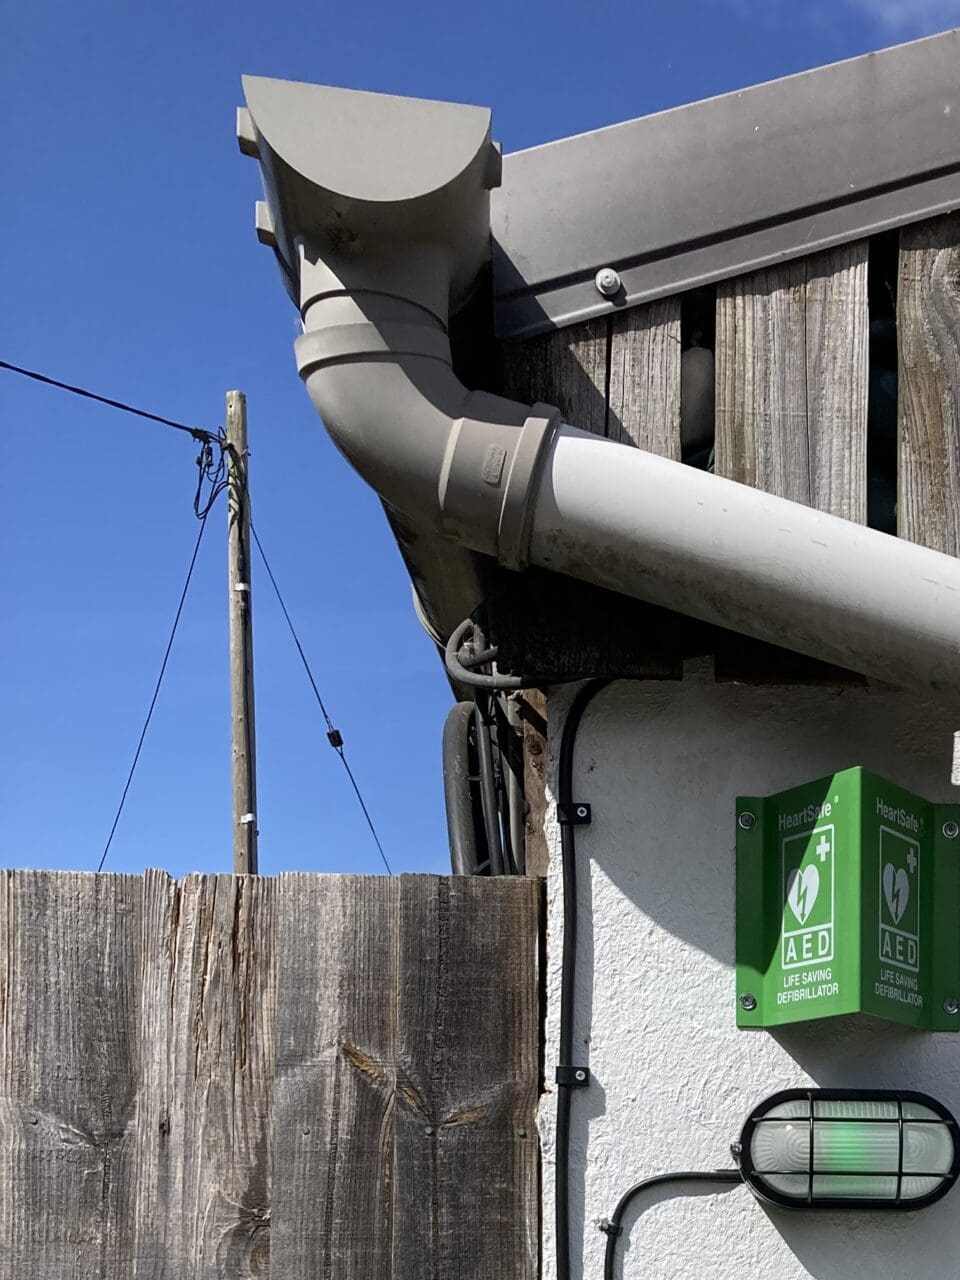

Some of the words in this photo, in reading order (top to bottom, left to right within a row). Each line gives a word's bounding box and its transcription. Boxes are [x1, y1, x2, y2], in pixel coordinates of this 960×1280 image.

[784, 974, 799, 987] LIFE
[802, 968, 832, 984] SAVING
[881, 968, 894, 983] LIFE
[896, 974, 917, 990] SAVING
[777, 983, 839, 1005] DEFIBRILLATOR
[875, 983, 923, 1008] DEFIBRILLATOR
